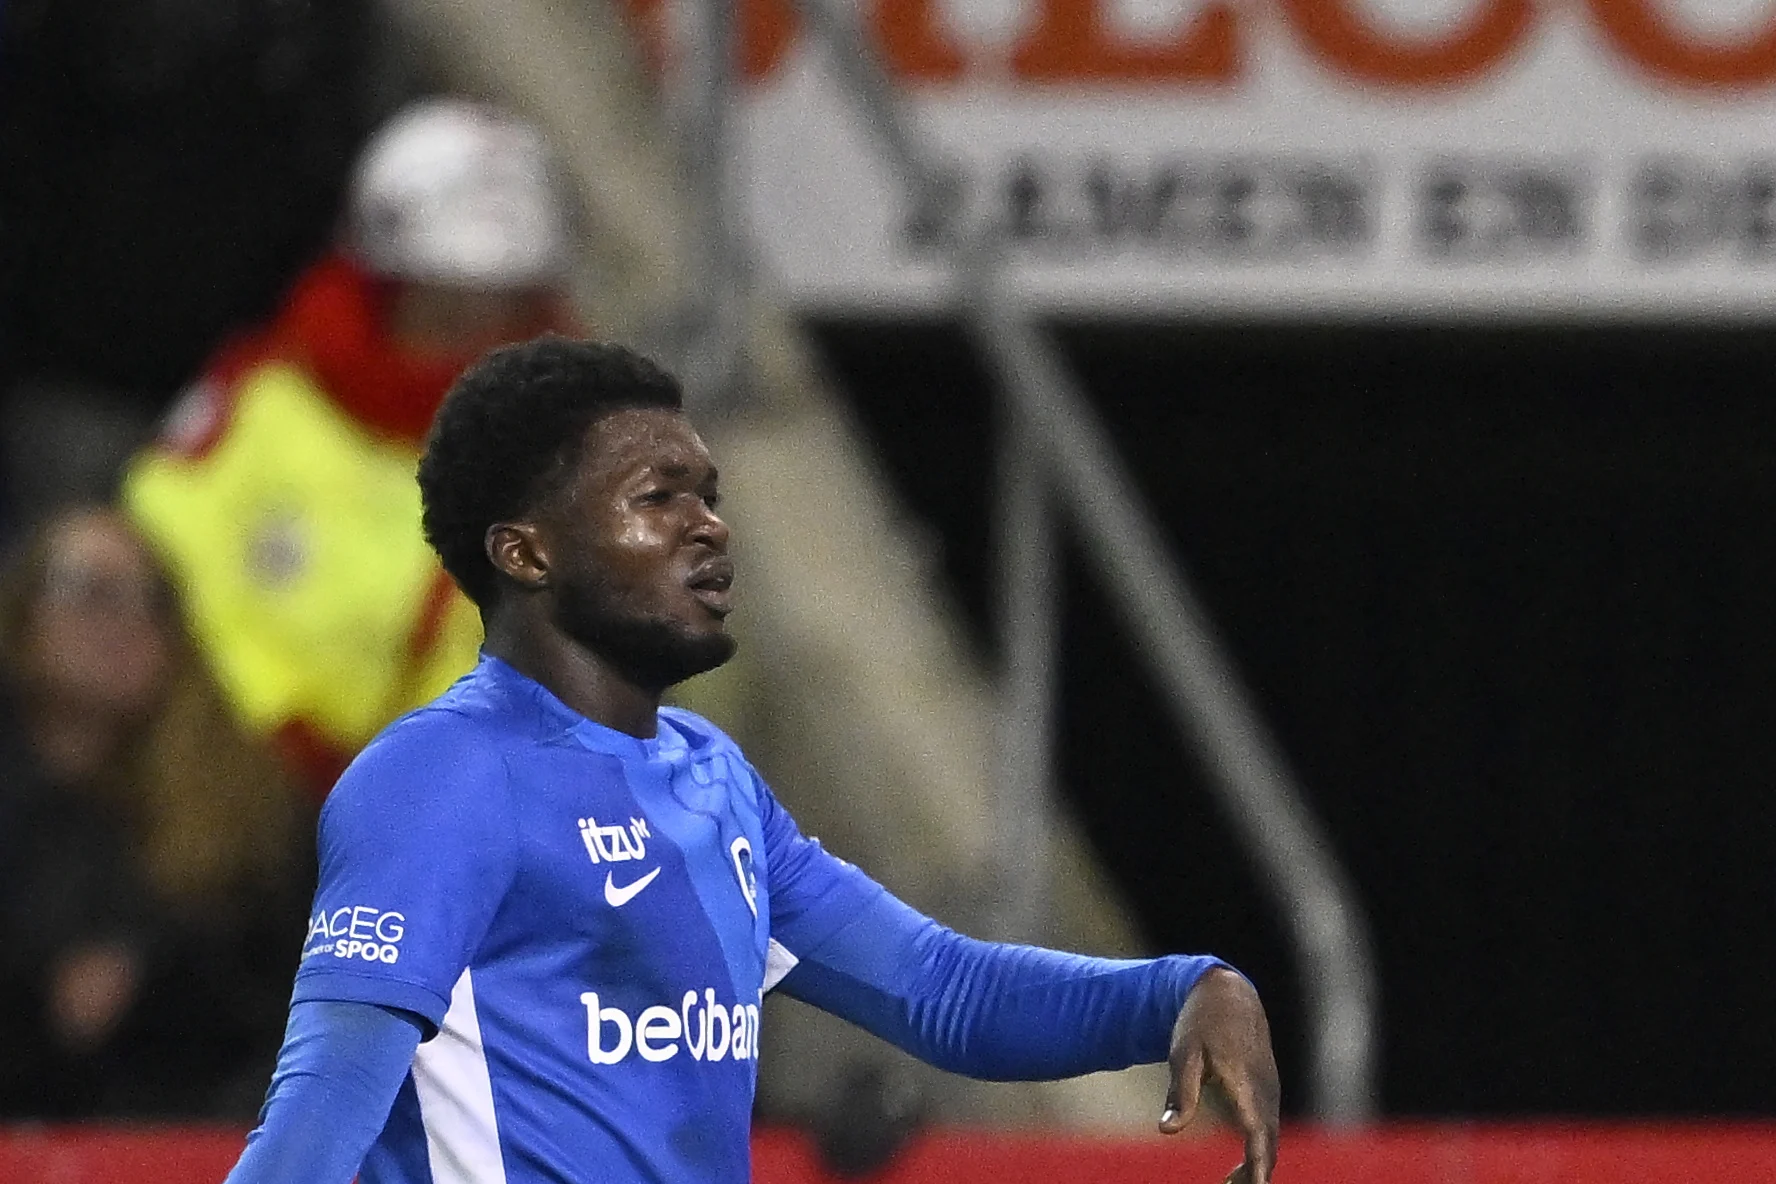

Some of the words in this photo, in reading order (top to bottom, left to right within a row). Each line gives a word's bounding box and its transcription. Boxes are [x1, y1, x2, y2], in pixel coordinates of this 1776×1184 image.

[305, 905, 406, 944] ACEG
[334, 939, 399, 964] SPOQ
[579, 987, 763, 1065] beoban
